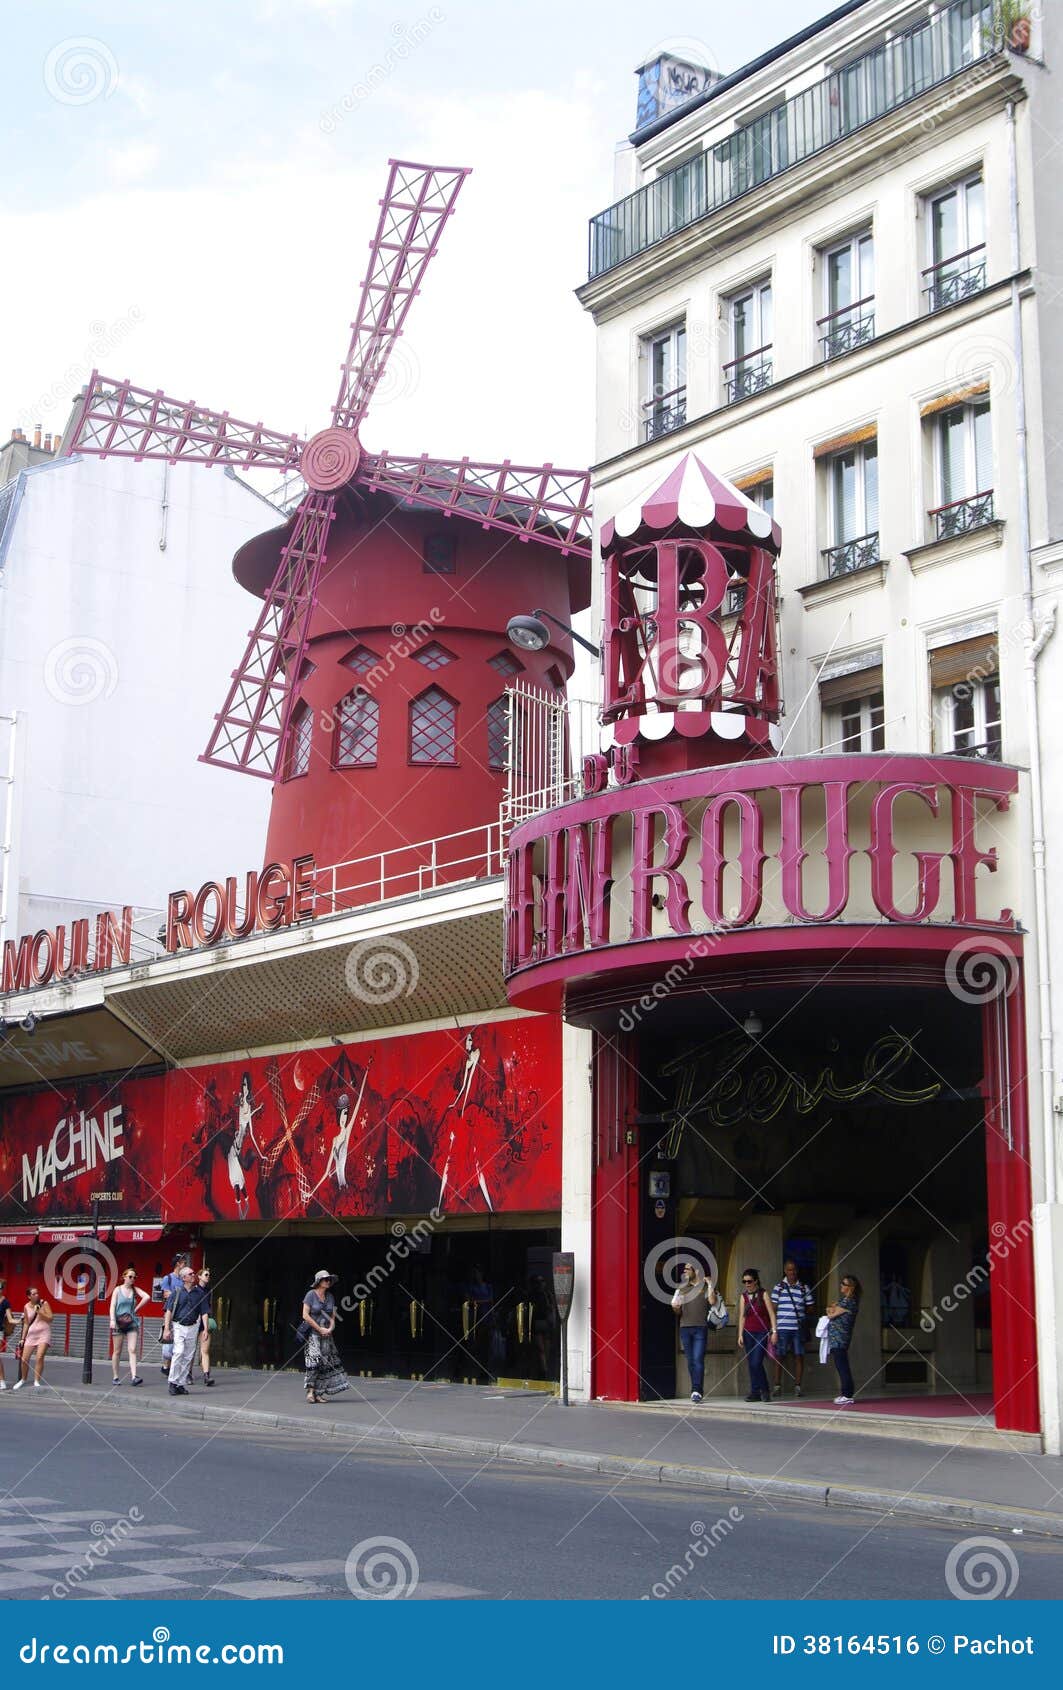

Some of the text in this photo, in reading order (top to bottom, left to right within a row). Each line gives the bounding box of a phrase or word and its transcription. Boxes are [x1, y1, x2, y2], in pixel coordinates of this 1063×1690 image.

[629, 780, 1016, 940] ROUGE
[1, 852, 318, 993] MOULIN ROUGE
[21, 1104, 125, 1202] MACHINE
[132, 1231, 144, 1240] BAR
